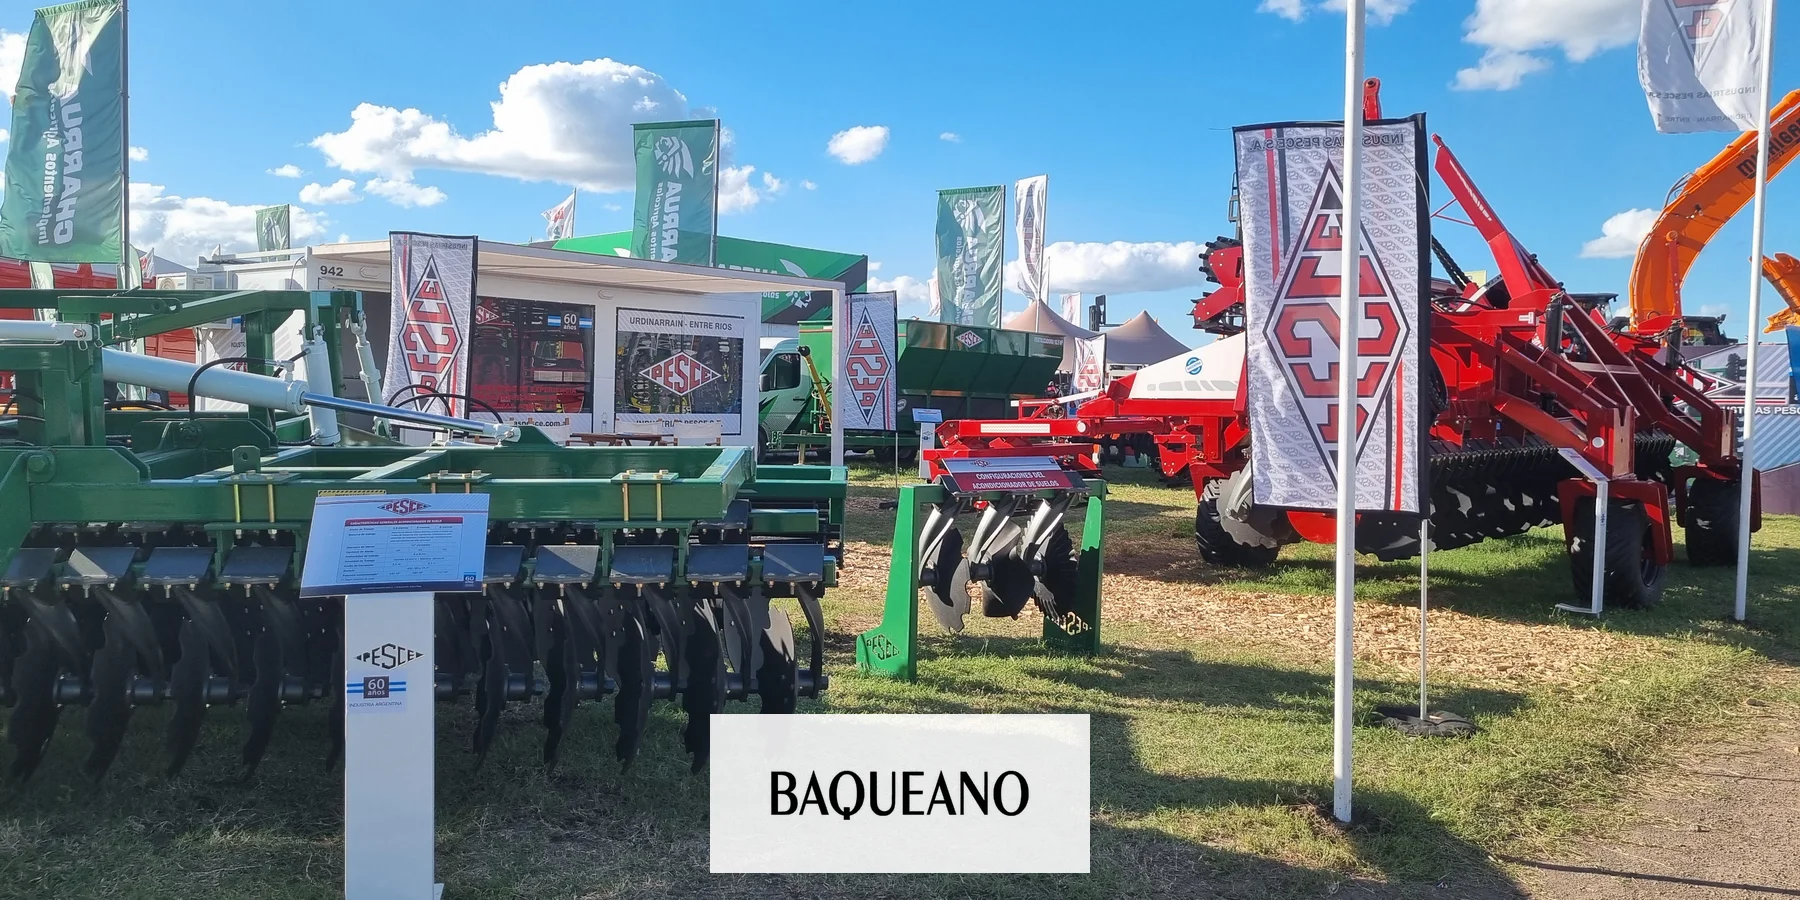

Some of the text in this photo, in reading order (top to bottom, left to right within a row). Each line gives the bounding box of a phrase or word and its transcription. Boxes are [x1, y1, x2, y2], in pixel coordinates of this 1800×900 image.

[320, 265, 344, 276] 942
[563, 313, 577, 324] 60
[629, 316, 683, 328] URDINARRAIN
[689, 320, 713, 330] ENTRE
[714, 322, 732, 331] RIOS
[651, 354, 711, 394] PESCE
[976, 471, 1045, 480] CONFIGURACIONES DEL
[972, 481, 1027, 490] ACONDICIONADOR
[1036, 479, 1060, 487] SUELOS
[385, 499, 424, 514] PESCE
[865, 633, 900, 661] PESCE
[362, 642, 415, 670] PESCE
[367, 678, 385, 690] 60
